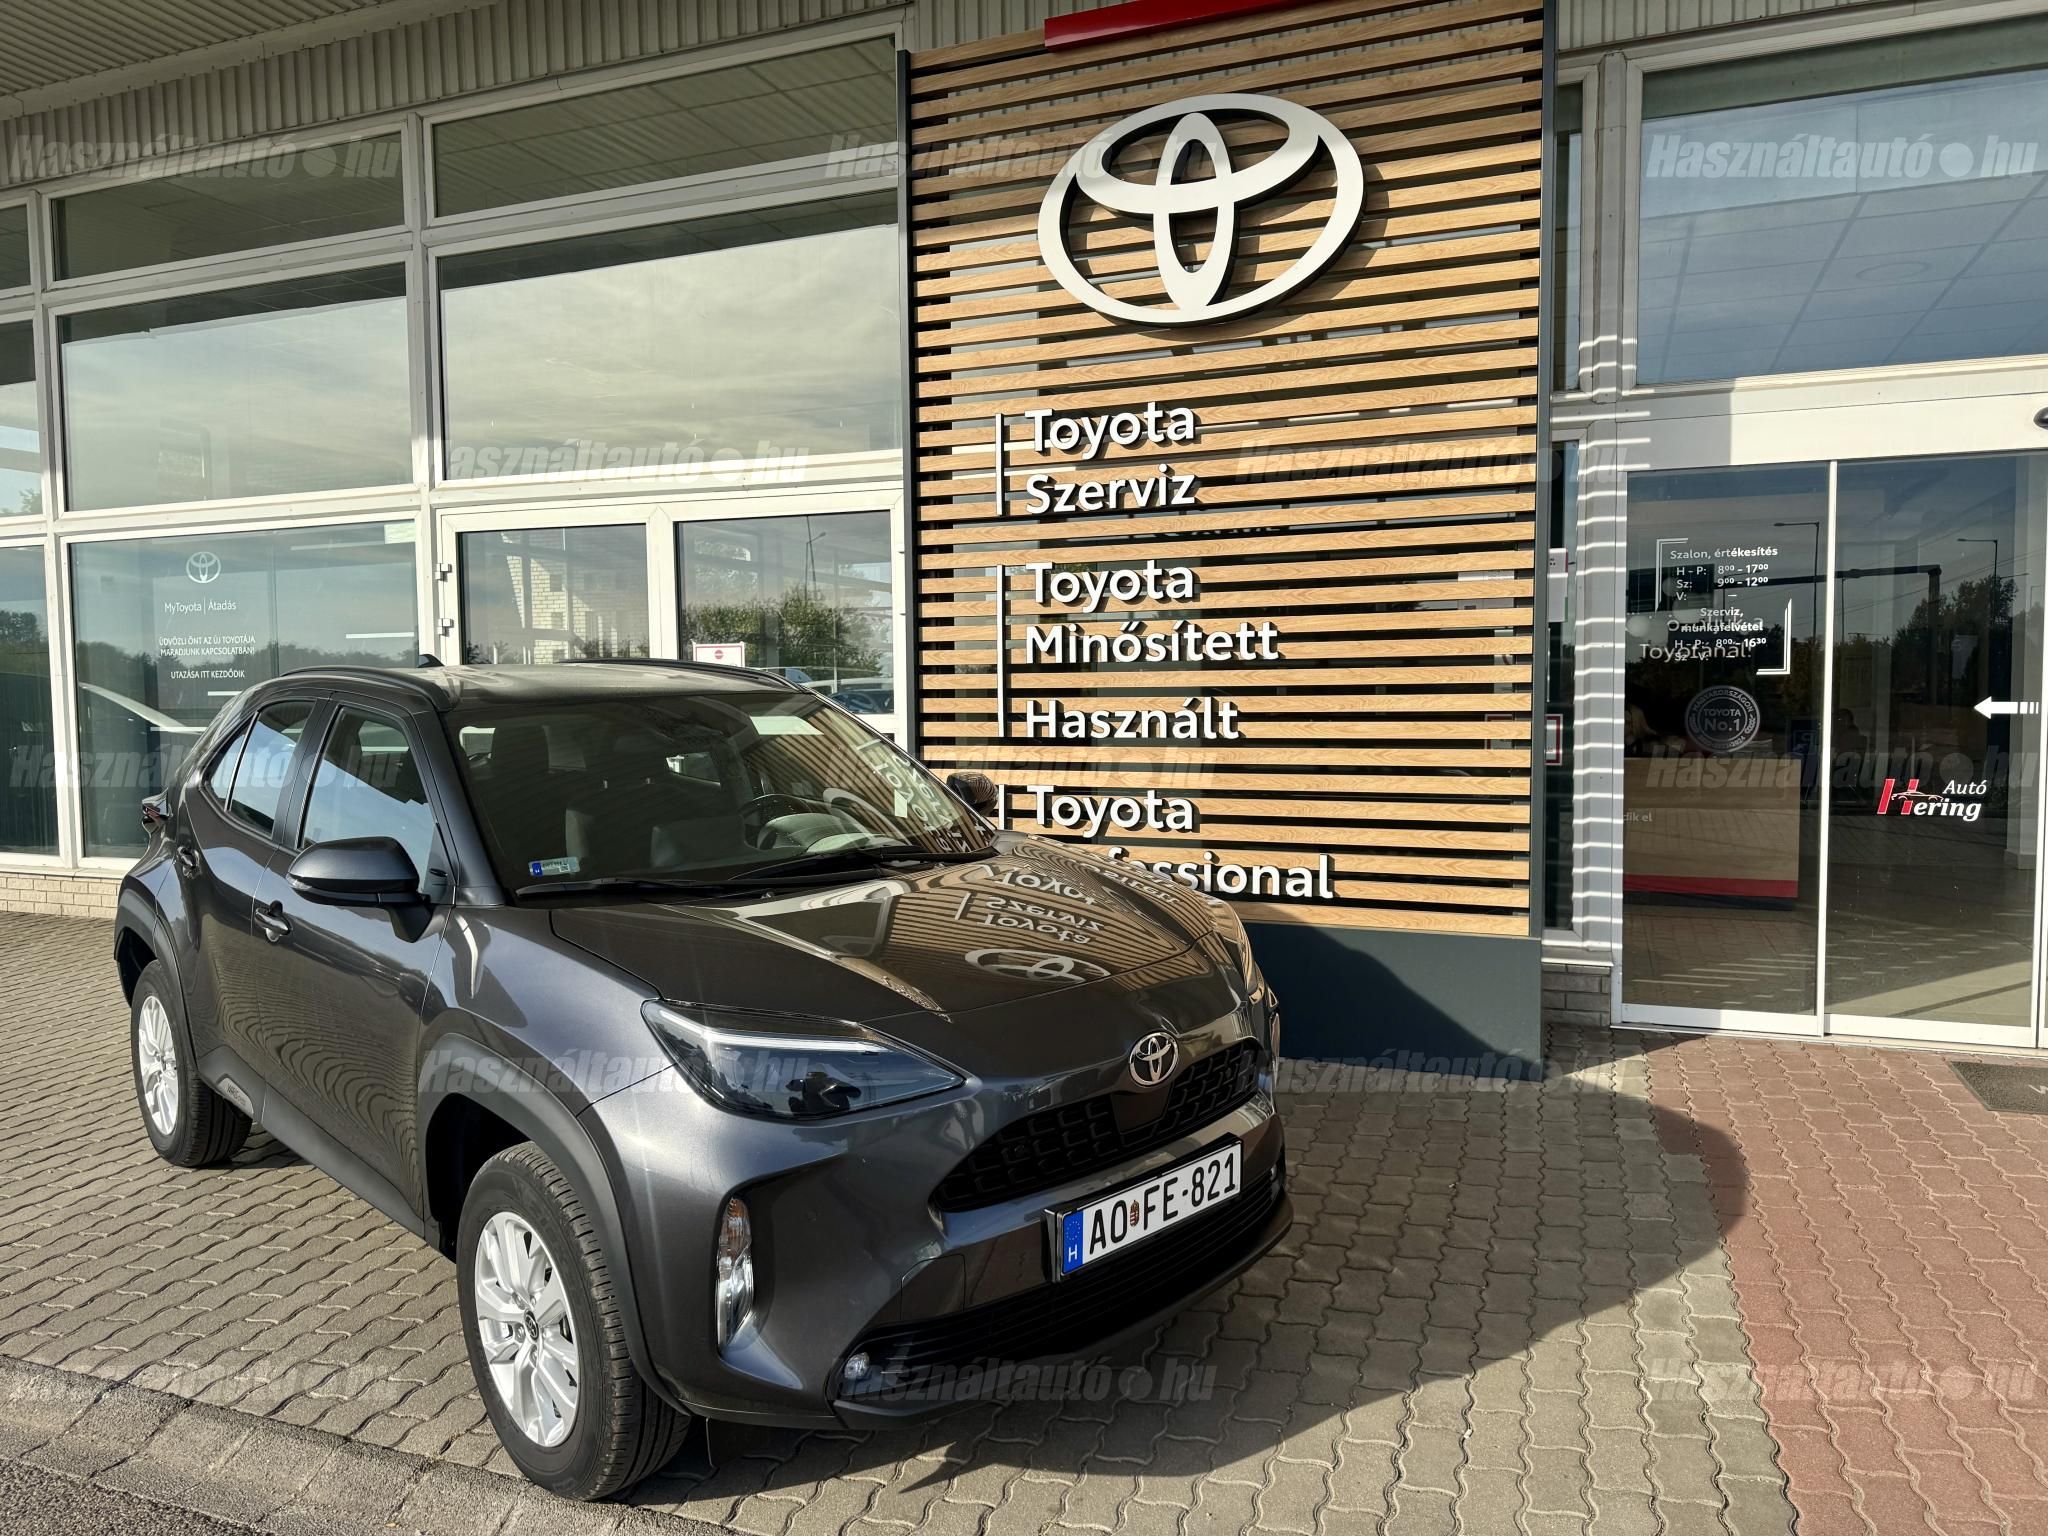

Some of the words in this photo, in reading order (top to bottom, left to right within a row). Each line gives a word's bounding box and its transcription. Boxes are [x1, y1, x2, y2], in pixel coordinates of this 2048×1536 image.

[1025, 402, 1195, 460] Toyota
[1026, 464, 1196, 514] Szerviz
[1670, 549, 1711, 559] Szalon,
[1714, 547, 1778, 558] értékesítés
[1026, 559, 1194, 613] Toyota
[1676, 579, 1693, 588] Sz:
[164, 602, 202, 615] MyToyota
[1700, 607, 1744, 618] Szerviz,
[1026, 620, 1280, 663] Minősített
[1026, 697, 1240, 739] Használt
[1703, 708, 1742, 717] TOYOTA
[1704, 718, 1740, 731] No.1
[1877, 779, 1982, 822] Hering
[1942, 780, 1987, 795] Autó
[1027, 785, 1194, 838] Toyota
[1108, 846, 1334, 899] ssional
[1089, 1200, 1128, 1255] AO
[1143, 1152, 1237, 1231] FE-821
[1068, 1244, 1078, 1263] H
